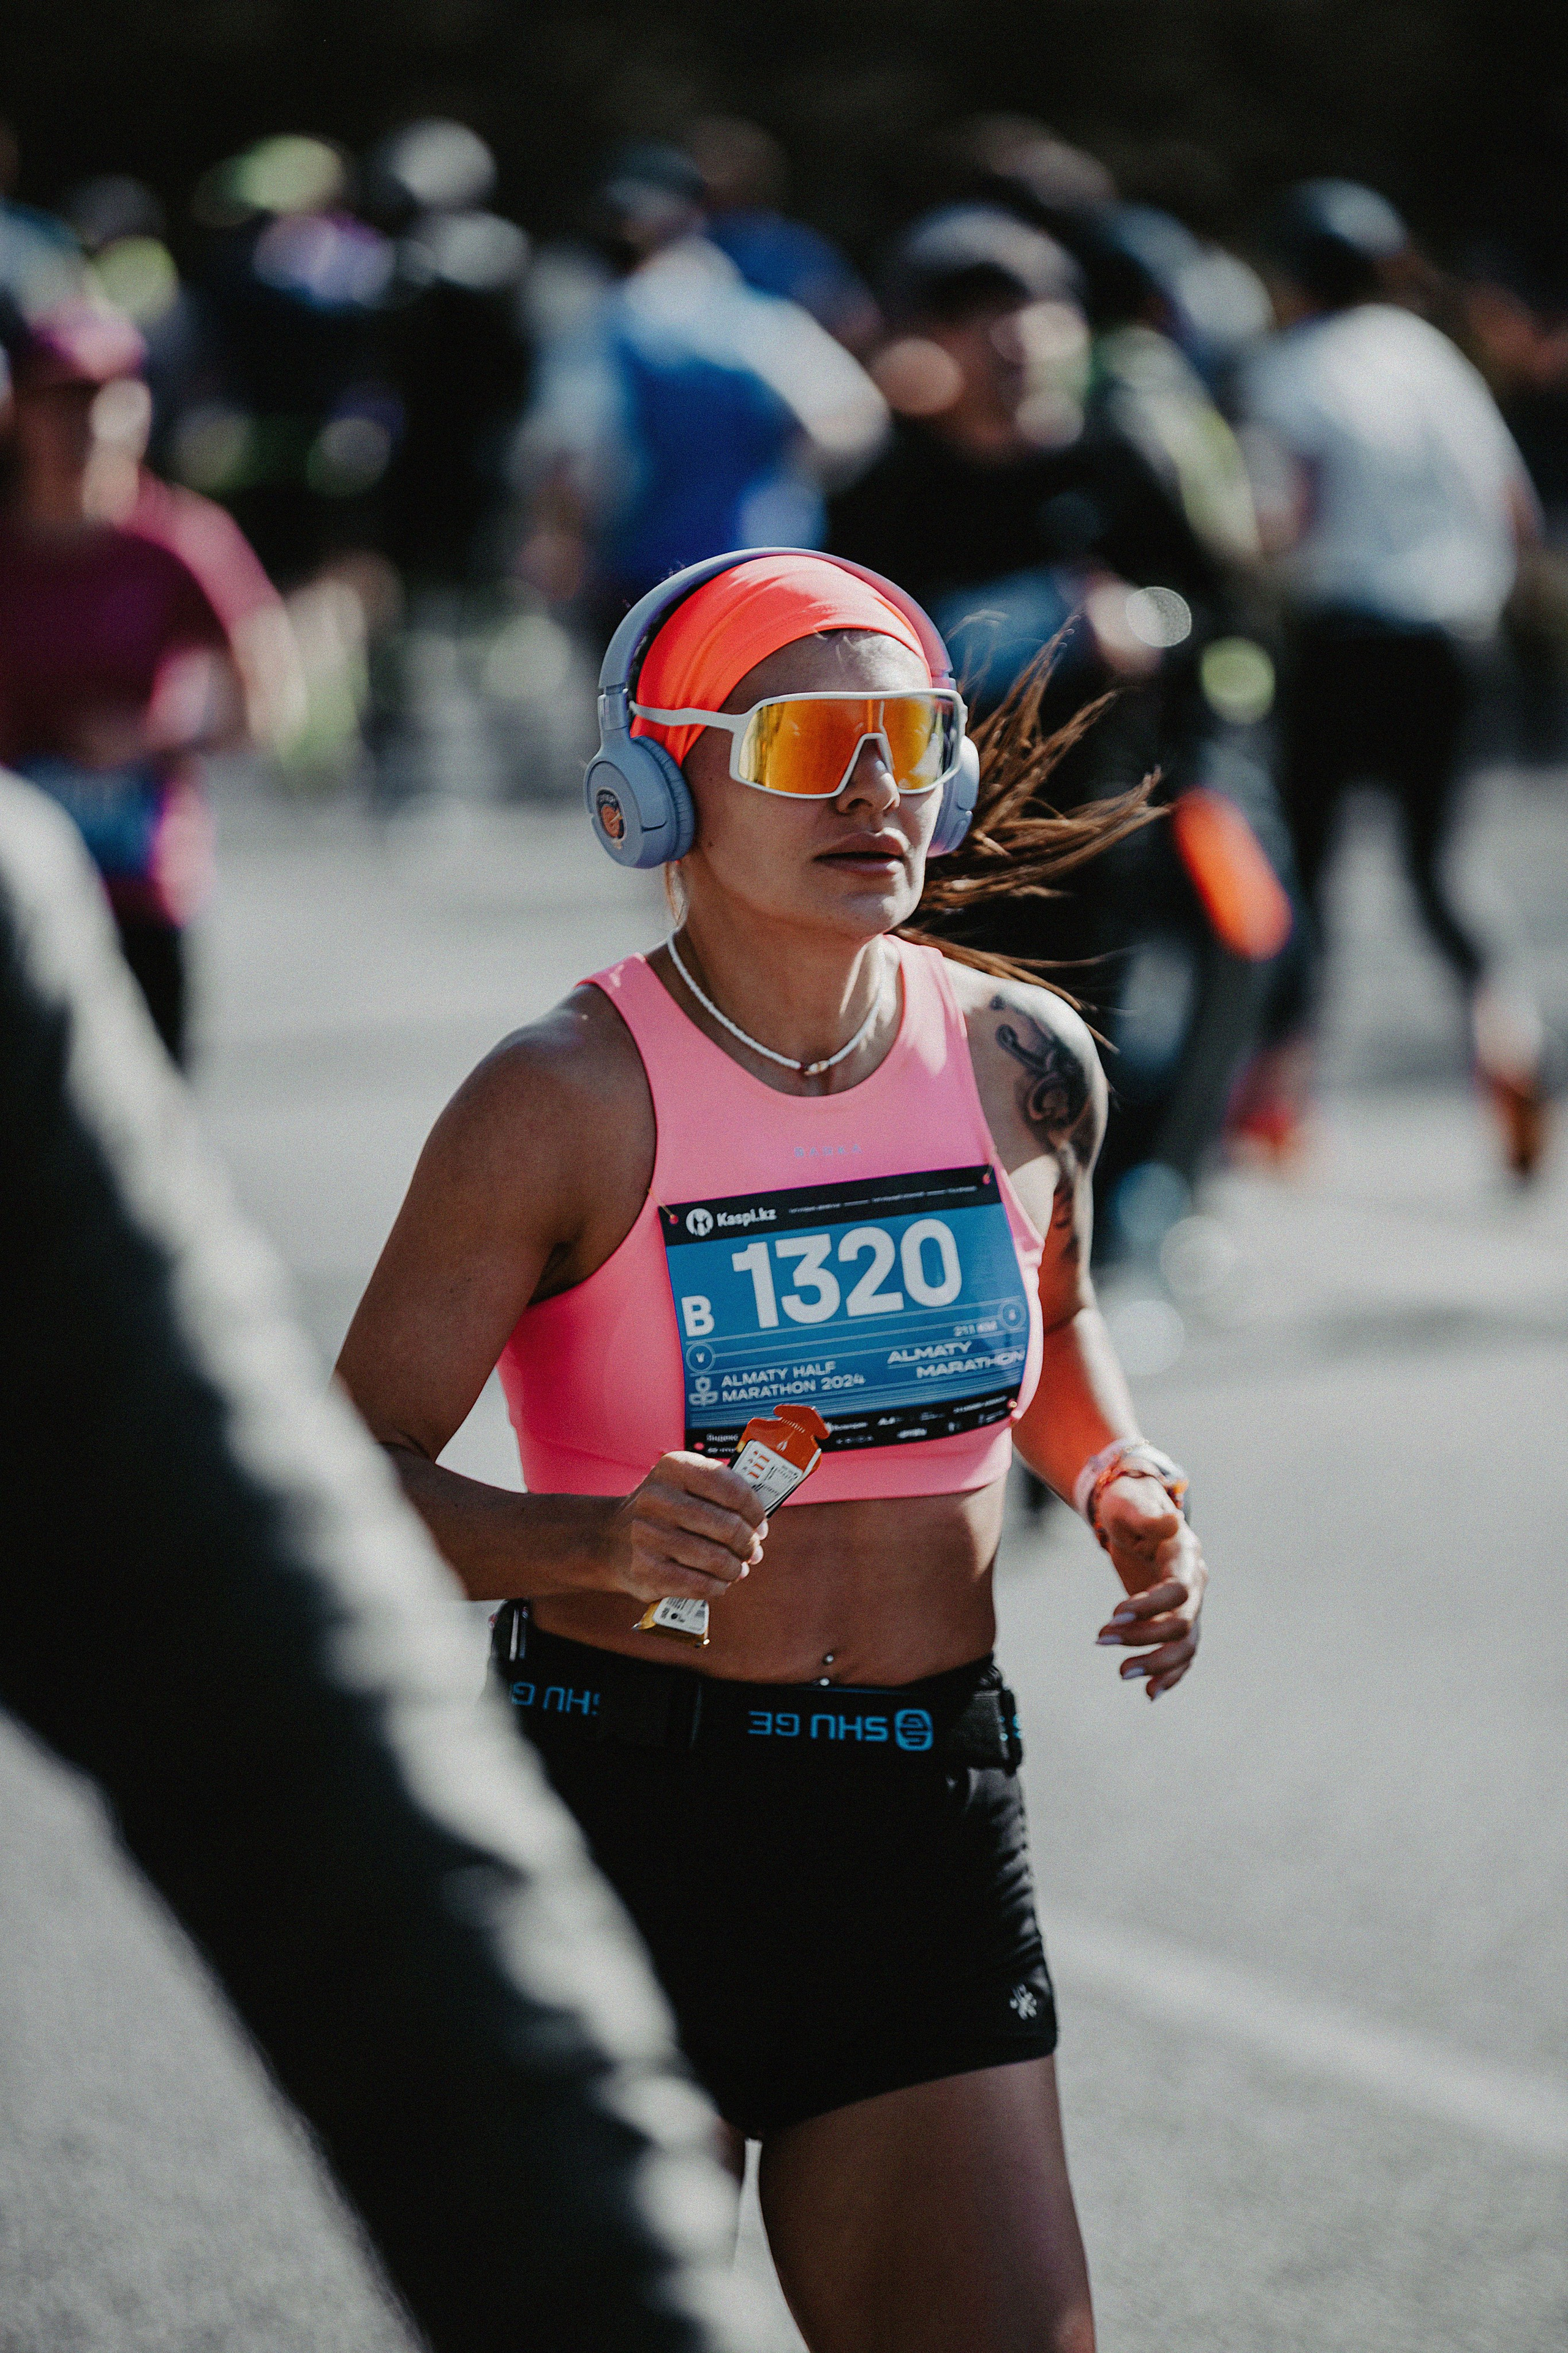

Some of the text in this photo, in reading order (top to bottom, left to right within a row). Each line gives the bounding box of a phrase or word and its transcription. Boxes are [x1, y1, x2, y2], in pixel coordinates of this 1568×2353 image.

[717, 1207, 777, 1226] Kaspi.kz
[731, 1218, 962, 1329] 1320
[681, 1295, 715, 1337] B
[887, 1340, 972, 1364] ALMATY
[916, 1350, 1025, 1378] MARATHON
[721, 1361, 836, 1388] ALMATY HALF
[722, 1373, 865, 1403] MARATHON 2024
[747, 1710, 888, 1742] SHU GE
